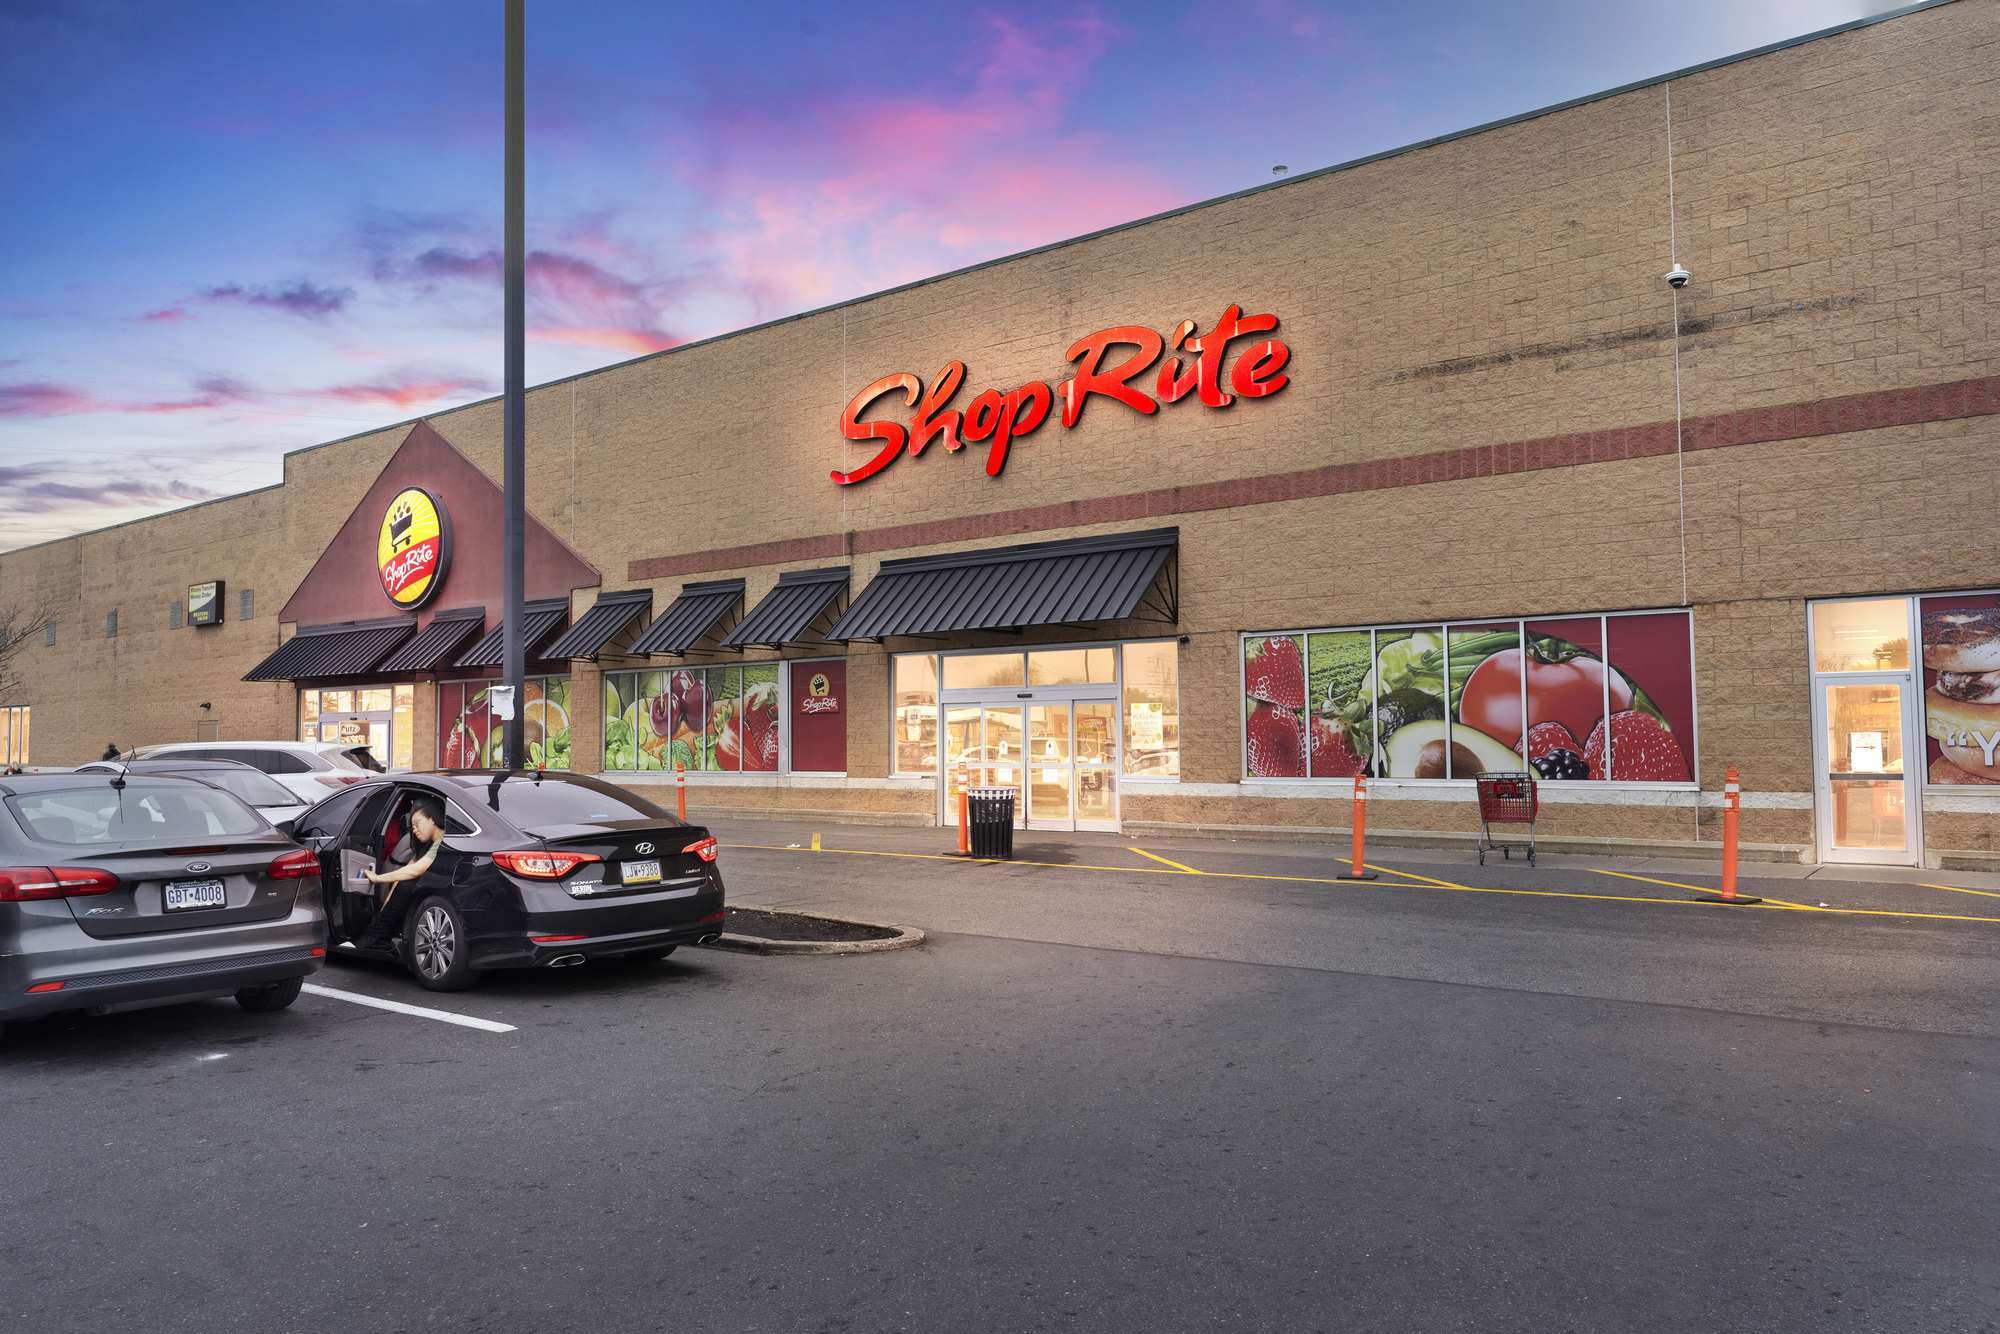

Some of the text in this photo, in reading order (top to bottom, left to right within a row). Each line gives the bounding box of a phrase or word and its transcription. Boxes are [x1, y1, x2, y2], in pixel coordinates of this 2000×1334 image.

[830, 303, 1292, 486] ShopRite
[385, 543, 434, 591] ShopRite
[802, 697, 839, 713] ShopRite
